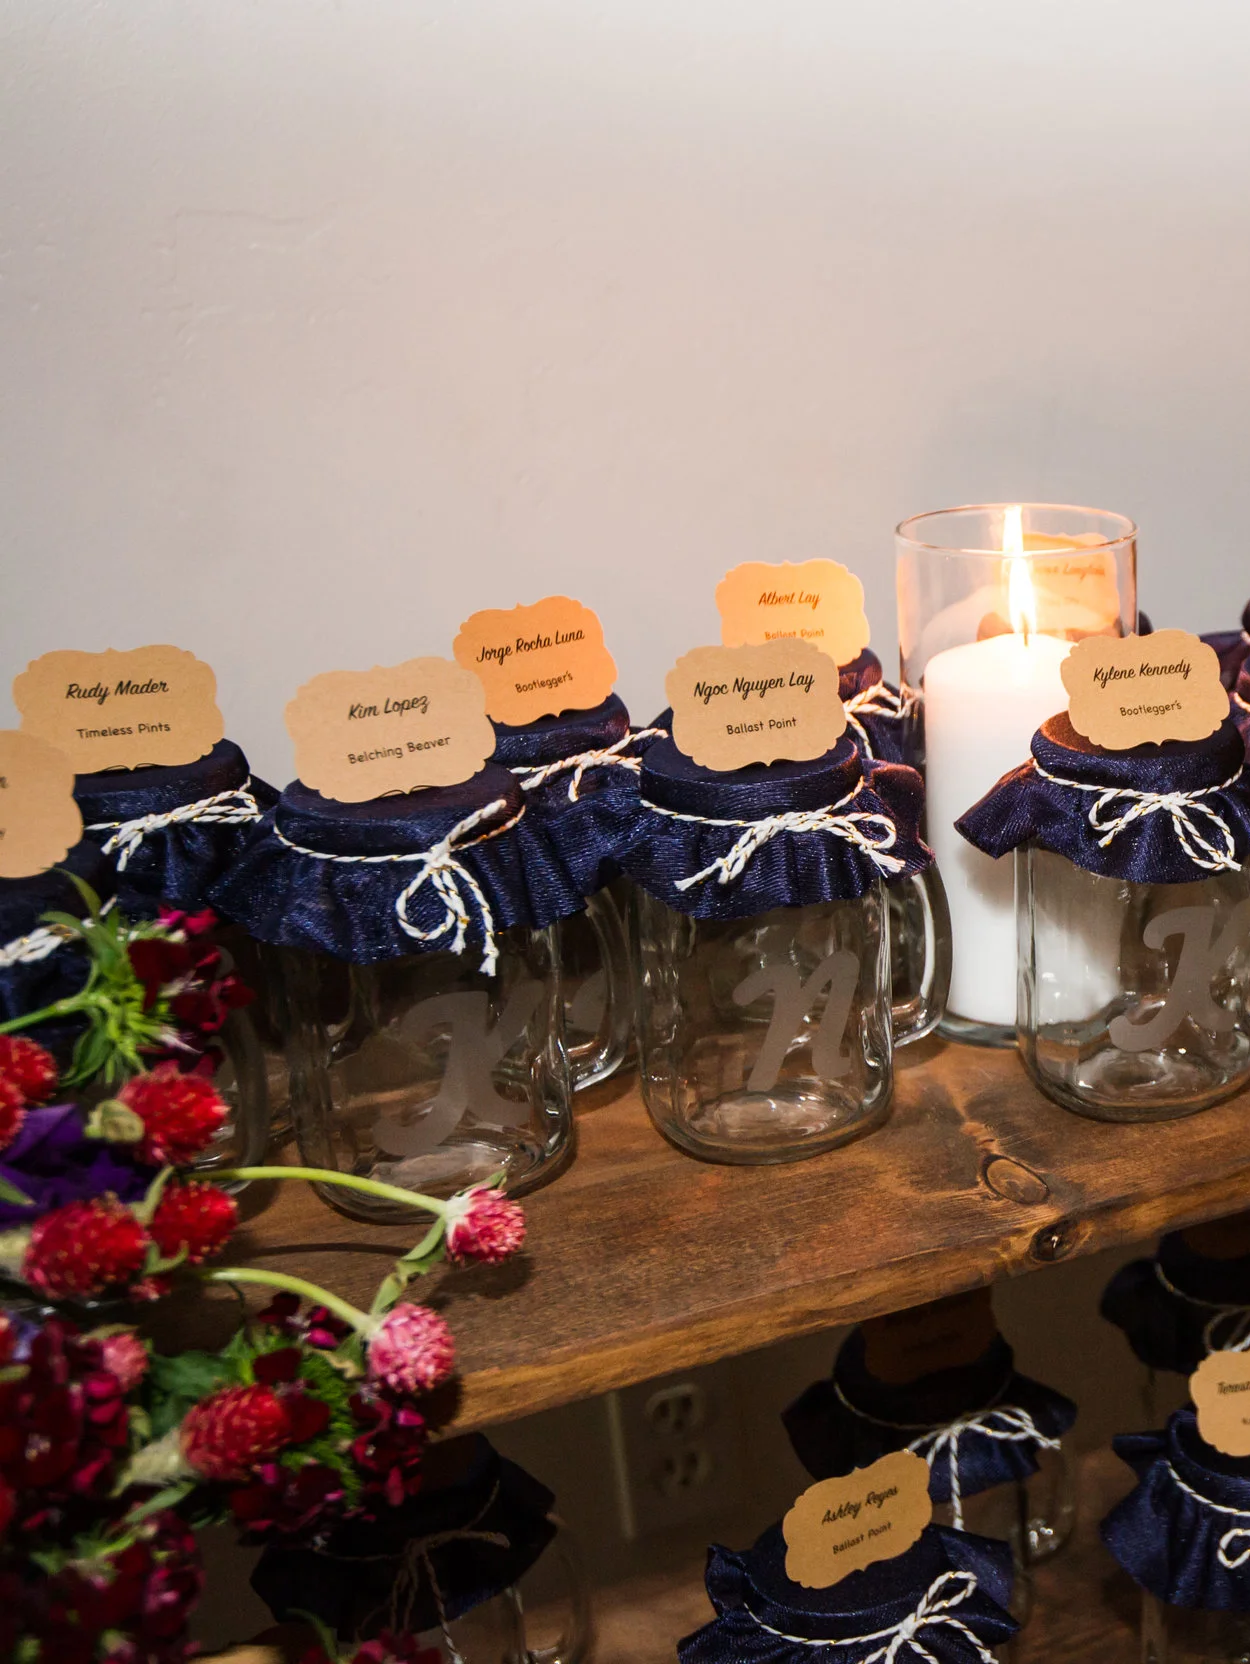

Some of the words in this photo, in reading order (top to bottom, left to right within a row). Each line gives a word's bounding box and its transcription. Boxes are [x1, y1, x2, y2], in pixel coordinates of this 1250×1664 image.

[758, 591, 796, 606] Albert
[798, 591, 821, 610] Lay
[764, 631, 797, 640] Ballast
[800, 628, 825, 638] Point
[476, 646, 513, 666] Jorge
[515, 633, 552, 653] Rocha
[555, 629, 585, 645] Luna
[515, 670, 573, 693] Bootlegger's
[1093, 666, 1136, 689] Kylene
[1138, 659, 1192, 680] Kennedy
[65, 682, 110, 705] Rudy
[114, 679, 169, 696] Mader
[693, 681, 729, 705] Ngoc
[732, 676, 785, 701] Nguyen
[788, 671, 815, 693] Lay
[347, 703, 380, 721] Kim
[383, 695, 430, 717] Lopez
[1119, 700, 1182, 717] Bootlegger's
[76, 726, 133, 739] Timeless
[137, 722, 171, 734] Pints
[726, 721, 764, 735] Ballast
[768, 717, 797, 730] Point
[347, 747, 403, 764] Belching
[406, 736, 451, 752] Beaver
[821, 1501, 862, 1525] Ashley
[832, 1533, 865, 1555] Ballast
[867, 1521, 892, 1539] Point
